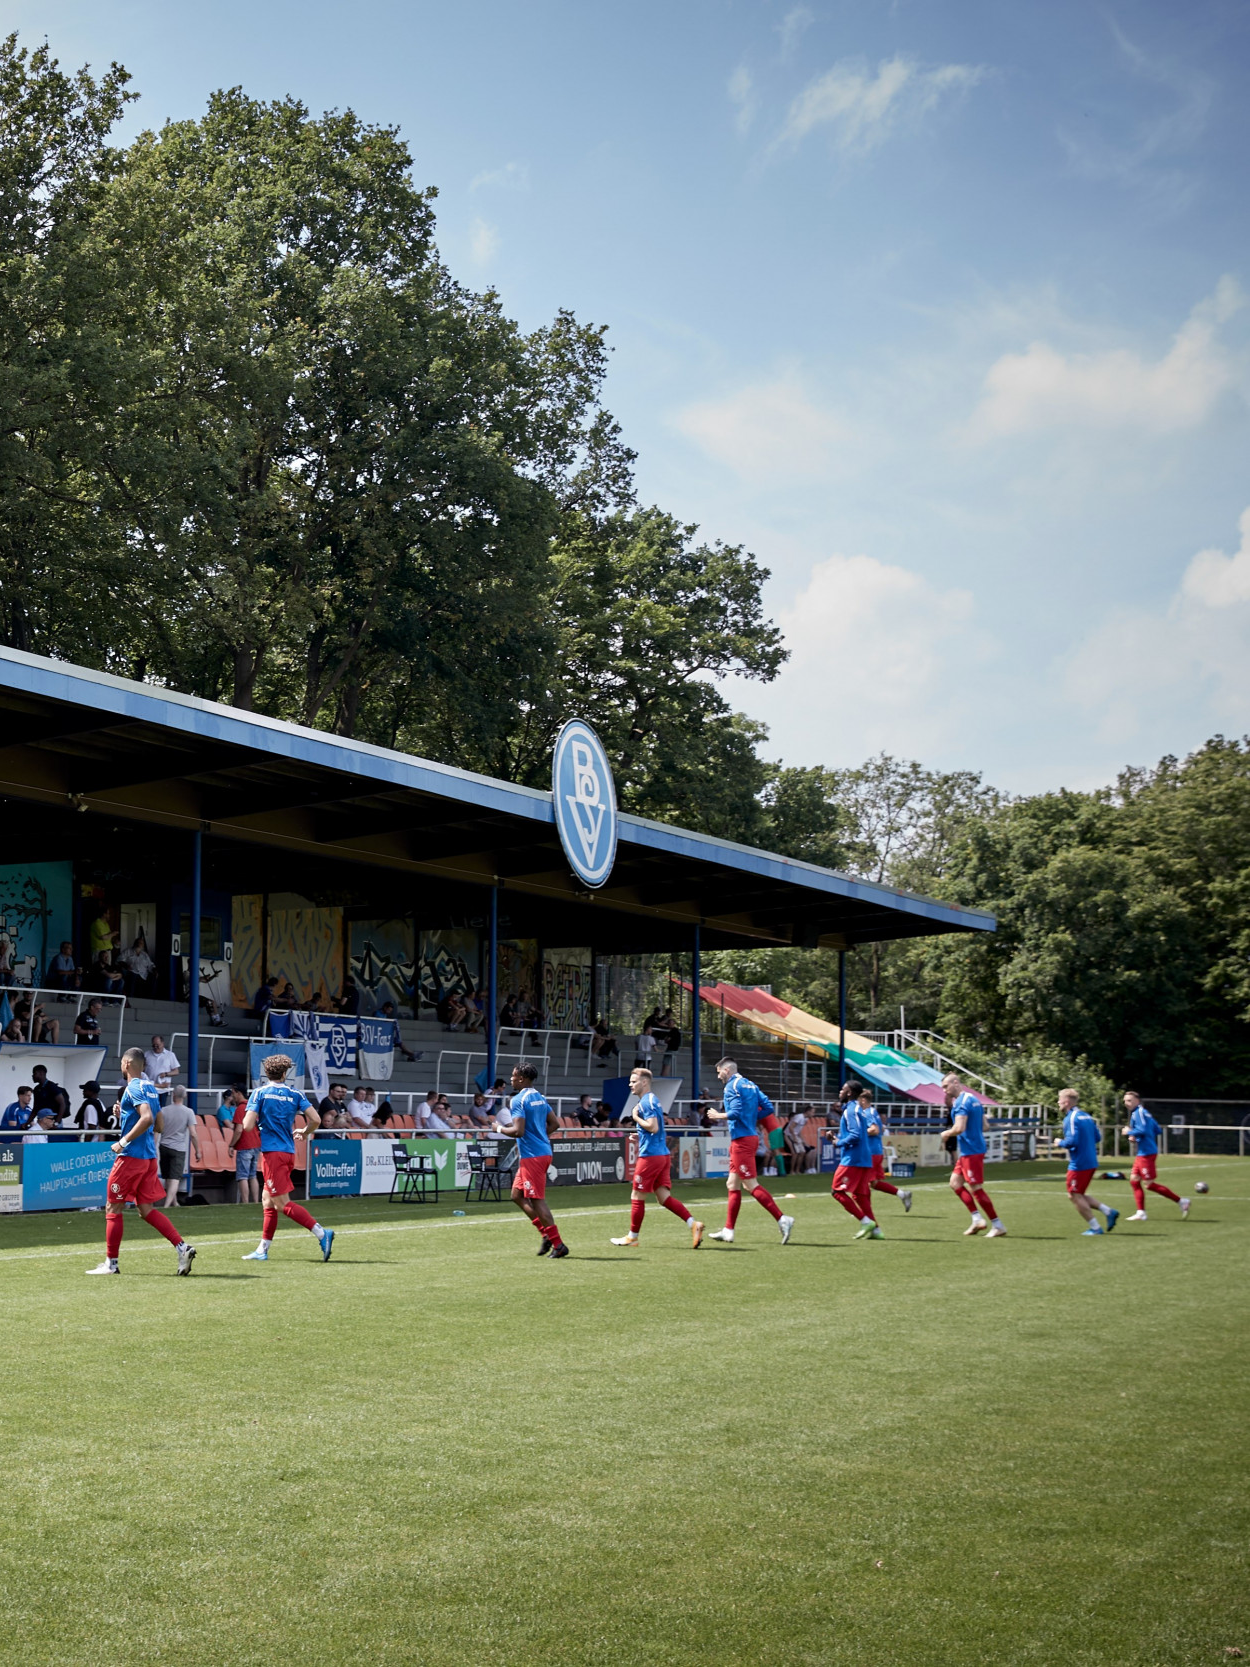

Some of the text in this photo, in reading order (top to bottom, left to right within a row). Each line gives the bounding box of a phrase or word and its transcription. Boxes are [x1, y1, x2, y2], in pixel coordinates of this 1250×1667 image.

[1, 1151, 14, 1162] als
[50, 1151, 117, 1173] WALLE ODER WESE
[315, 1163, 357, 1178] Volltreffer!
[577, 1161, 602, 1183] UNION
[40, 1173, 87, 1193] HAUPTSACHE
